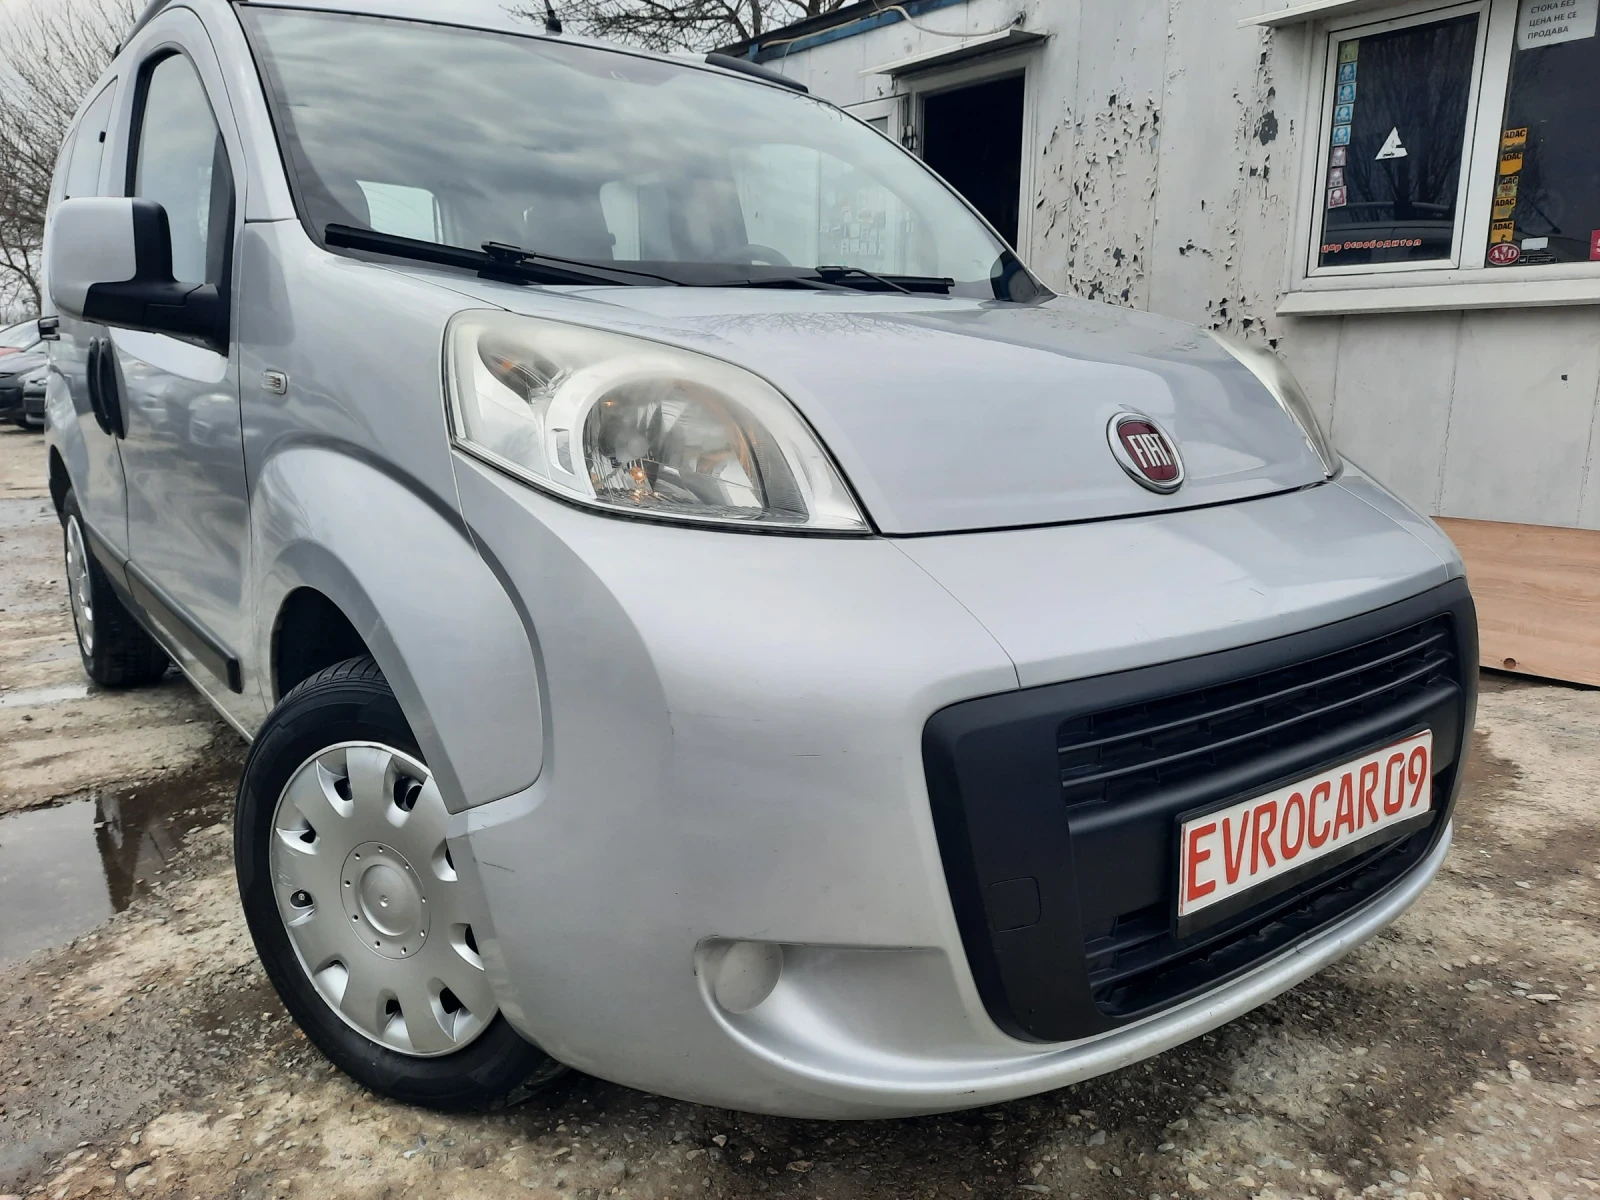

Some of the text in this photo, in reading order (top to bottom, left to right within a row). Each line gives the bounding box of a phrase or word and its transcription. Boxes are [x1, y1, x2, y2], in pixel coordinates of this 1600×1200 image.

[1531, 2, 1558, 13] СТОКА
[1529, 11, 1577, 27] ЦЕНА НЕ СЕ
[1528, 26, 1568, 39] ПРОДАВА
[1504, 130, 1525, 139] ADAC
[1502, 153, 1521, 162] ADAC
[1126, 433, 1172, 469] FIAT
[1187, 745, 1428, 902] EVROCAR09
